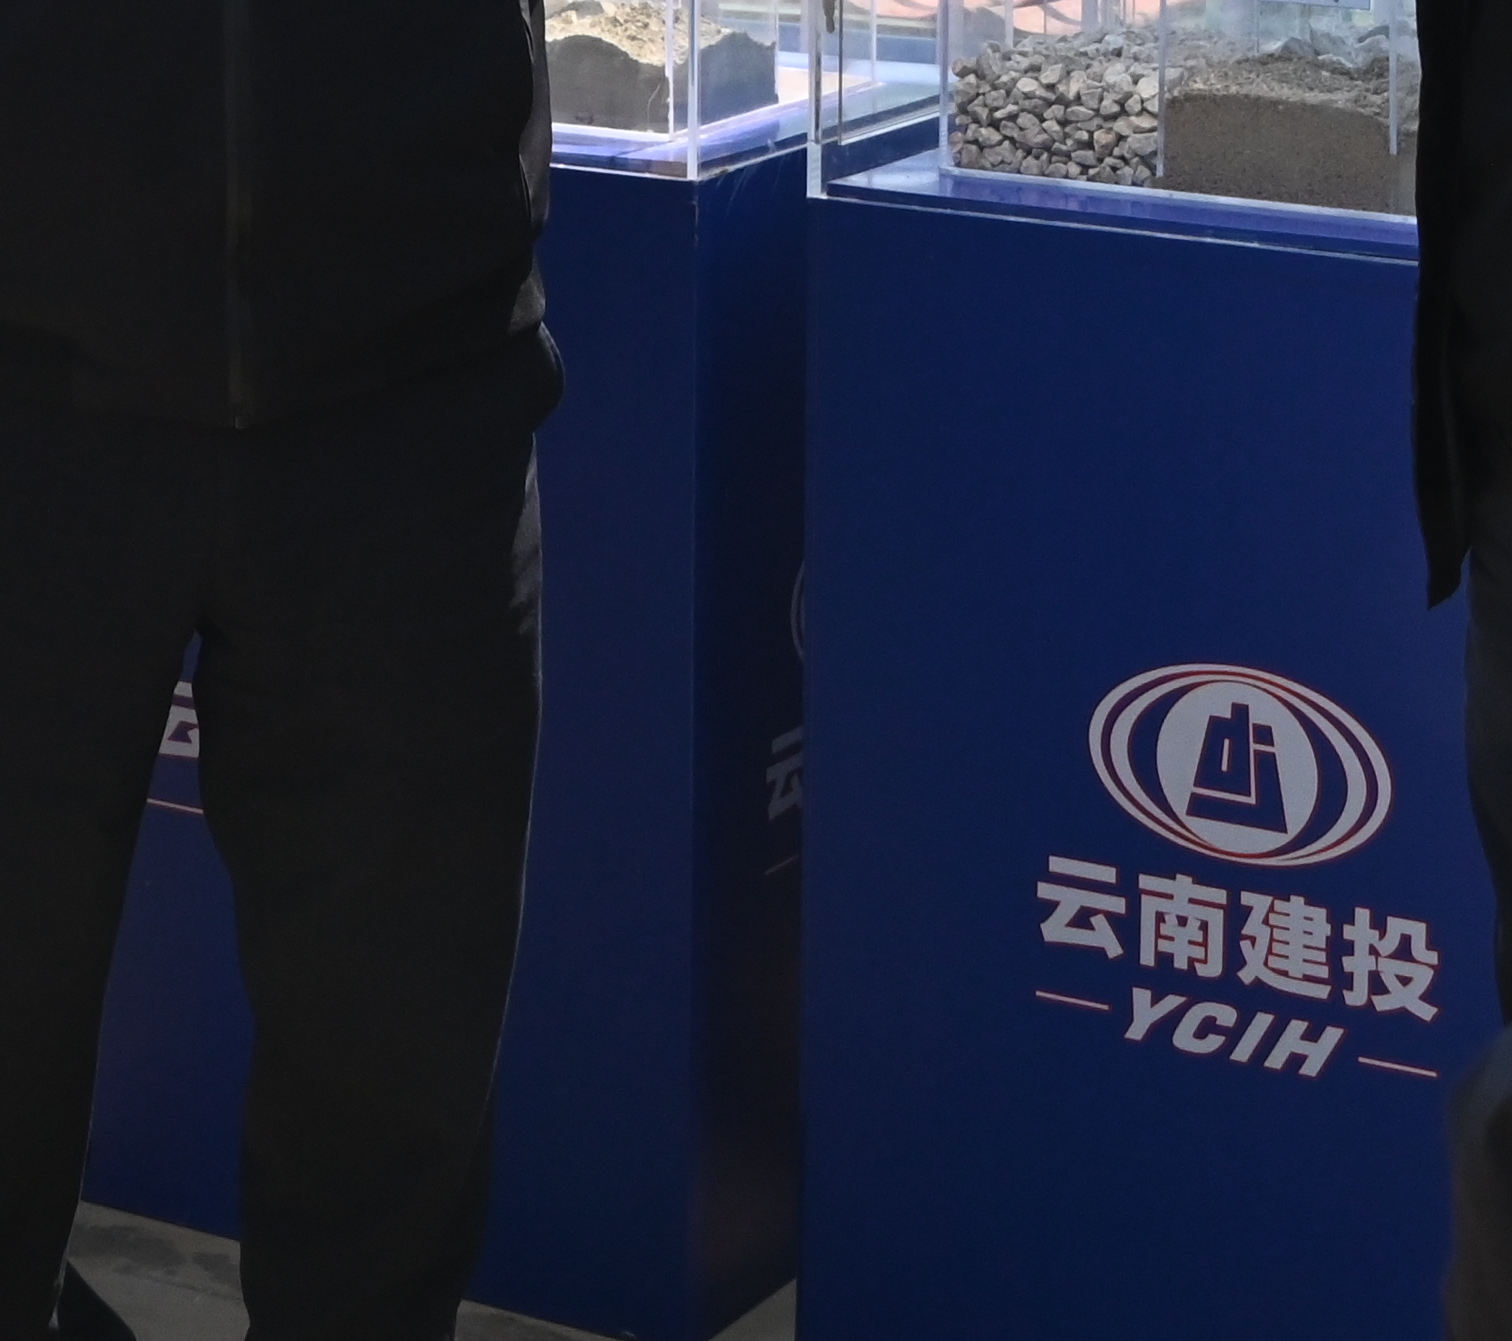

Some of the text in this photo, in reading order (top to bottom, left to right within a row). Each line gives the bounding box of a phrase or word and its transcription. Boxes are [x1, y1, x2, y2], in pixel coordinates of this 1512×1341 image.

[1036, 856, 1439, 1022] 云南建投
[1124, 987, 1344, 1078] YCIH
